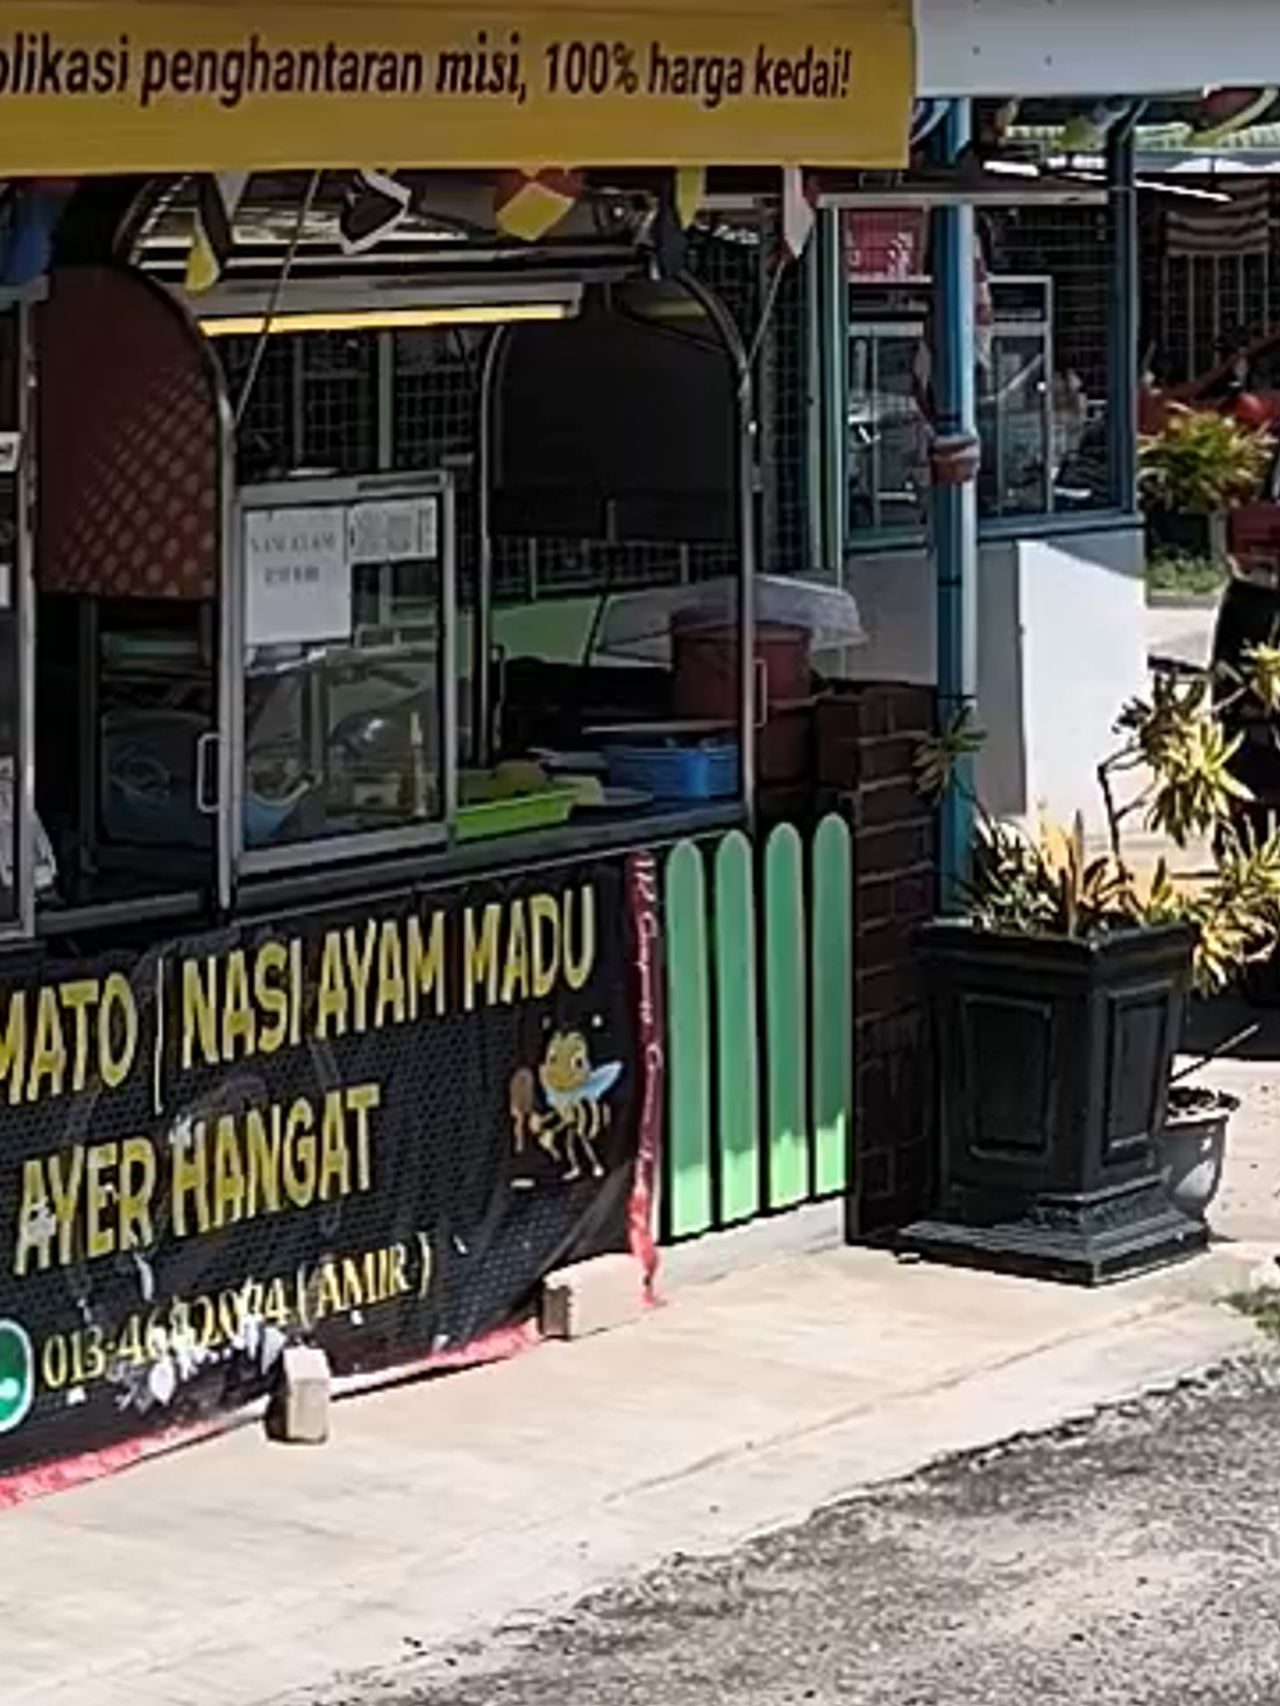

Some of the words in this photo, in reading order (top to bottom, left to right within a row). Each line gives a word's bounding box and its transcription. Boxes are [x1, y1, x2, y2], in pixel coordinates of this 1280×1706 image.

[139, 35, 423, 109] penghantaran
[433, 31, 528, 104] misi,
[544, 41, 639, 95] 100%
[647, 41, 745, 109] harga
[752, 43, 852, 99] kedai!
[179, 936, 304, 1069] NASI
[312, 911, 447, 1041] AYAM
[461, 884, 597, 1013] MADU
[13, 1136, 154, 1276] AYER
[167, 1084, 382, 1237] HANGAT
